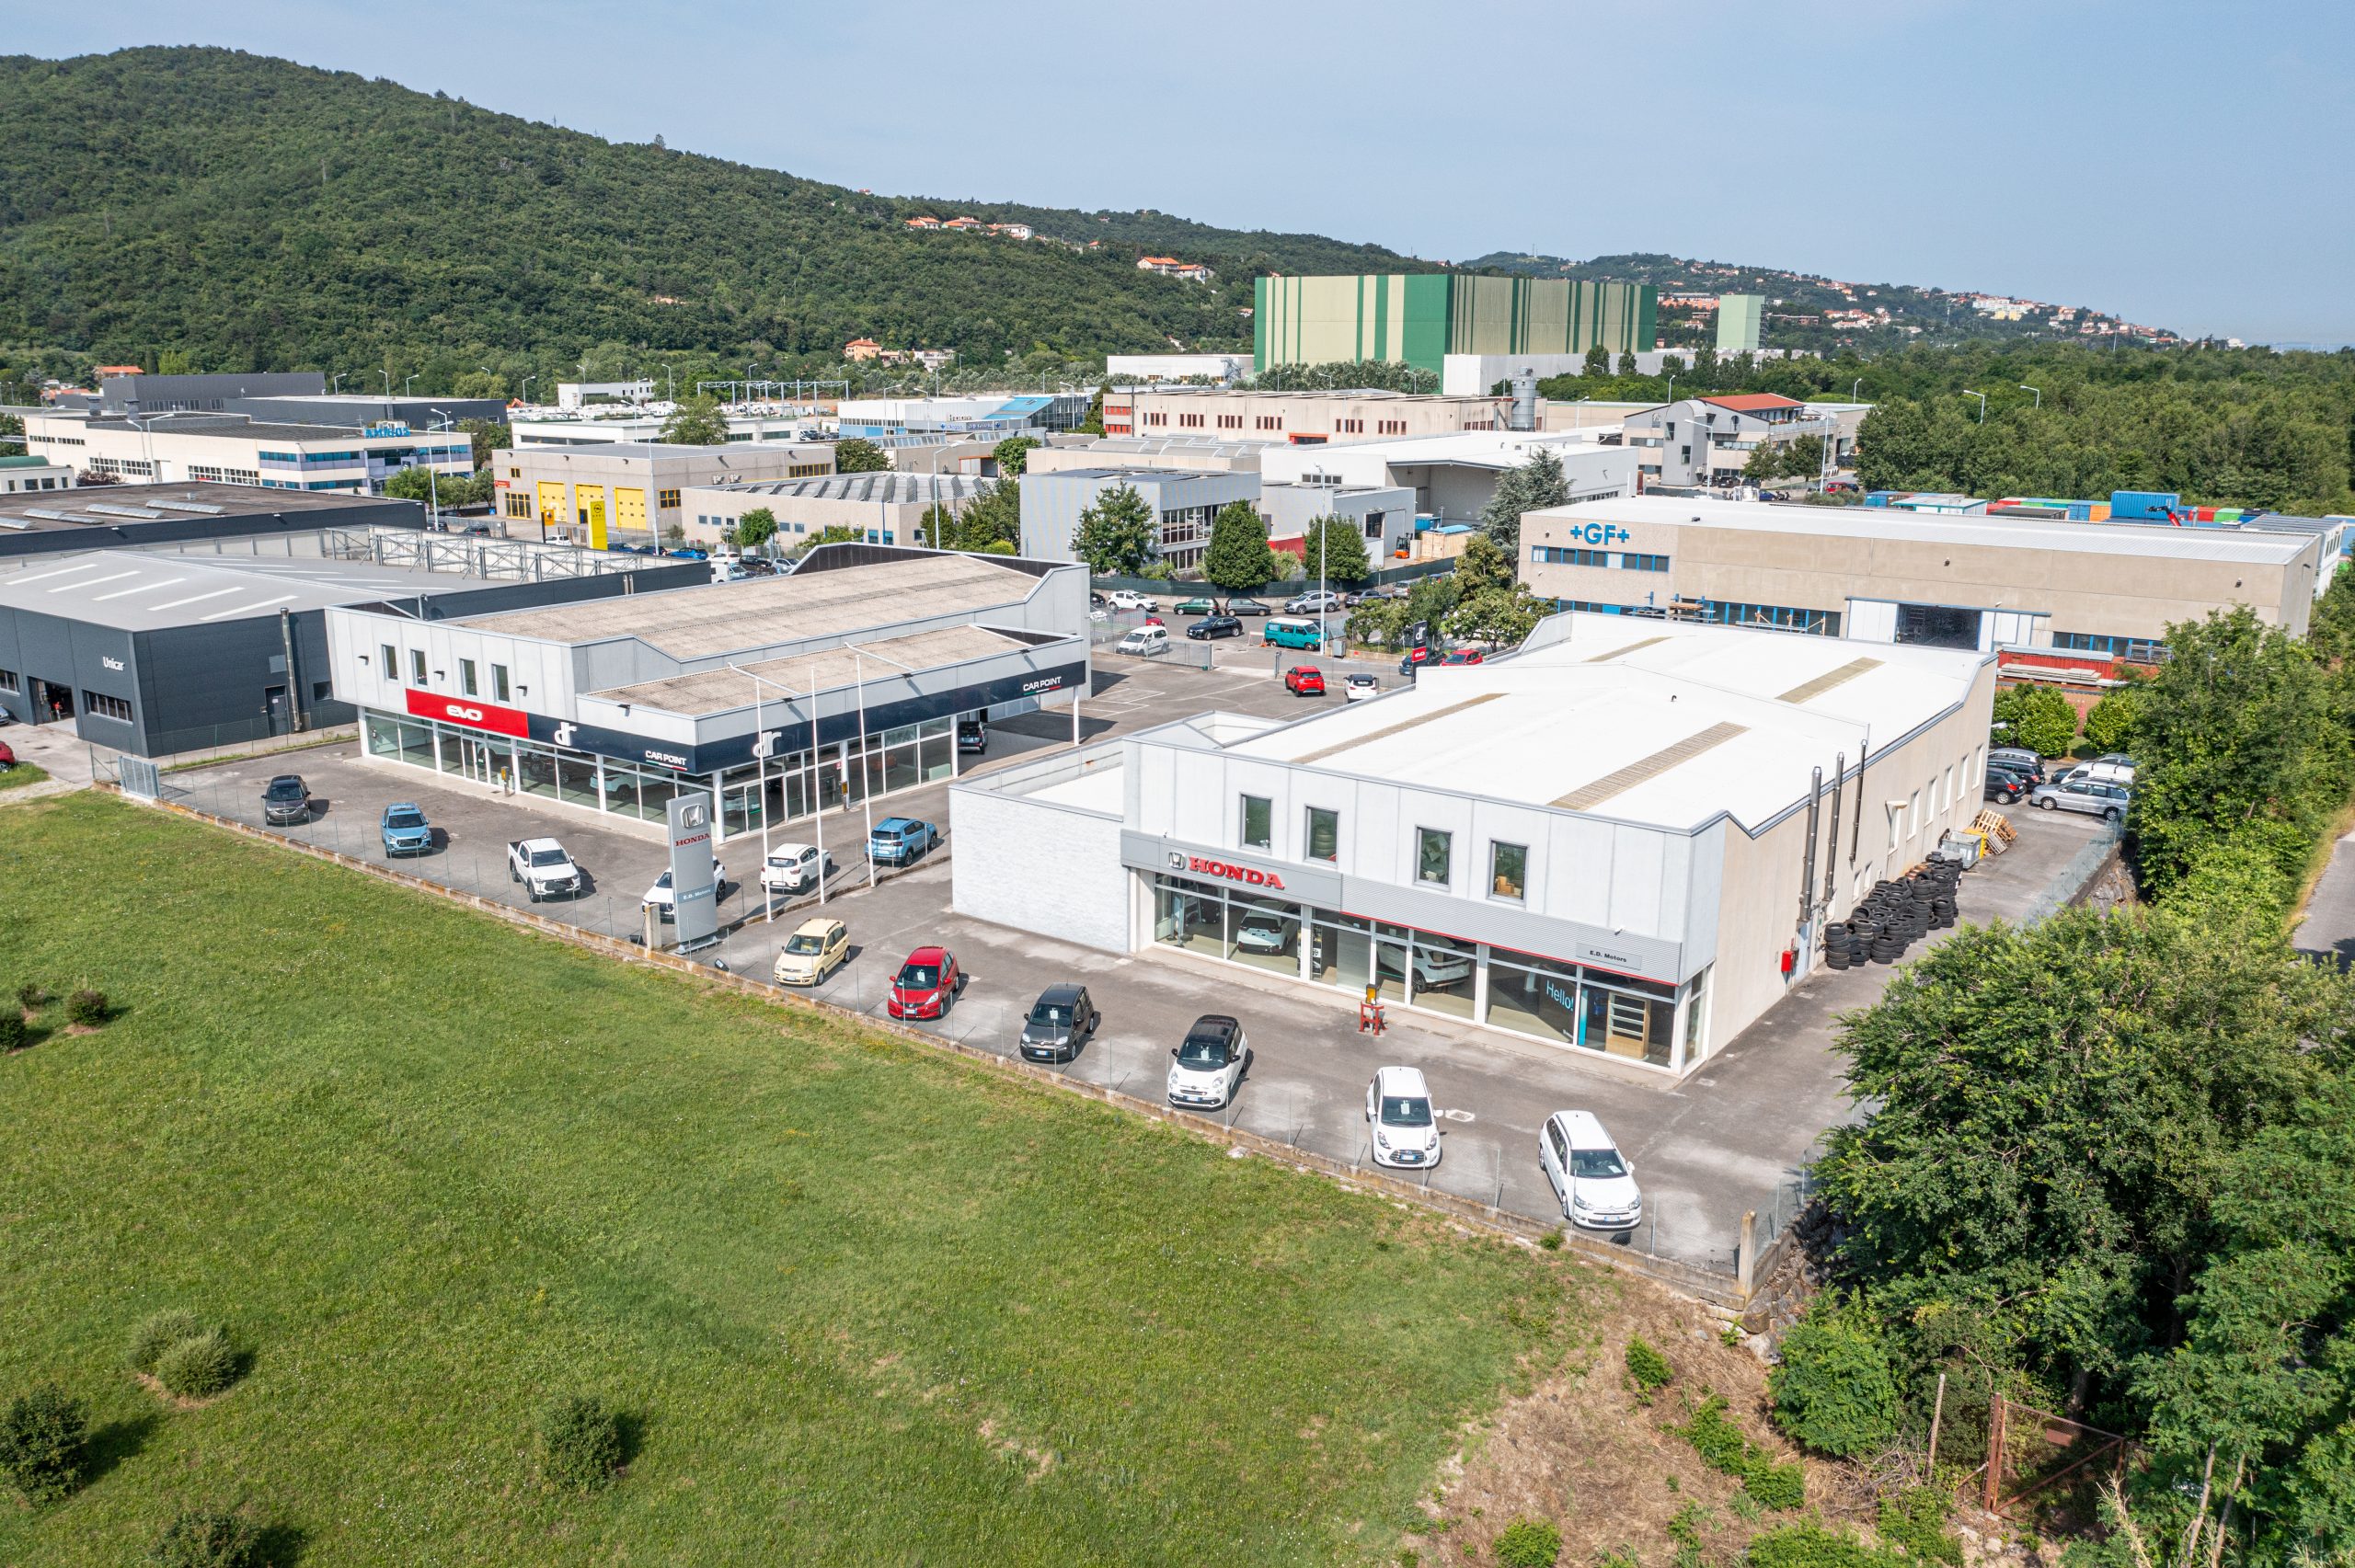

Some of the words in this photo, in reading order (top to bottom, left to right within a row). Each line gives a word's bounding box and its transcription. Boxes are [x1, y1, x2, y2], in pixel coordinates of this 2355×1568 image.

[102, 656, 125, 671] Unicar
[1023, 681, 1040, 692] CAR
[1040, 676, 1062, 688] POINT
[554, 722, 578, 747] dr
[752, 731, 782, 758] dr
[645, 750, 663, 761] CAR
[663, 753, 687, 766] POINT
[675, 832, 711, 847] HONDA
[1189, 855, 1286, 890] HONDA
[695, 888, 711, 898] Motors
[1604, 953, 1627, 963] Motors
[1546, 979, 1574, 1012] Hello!
